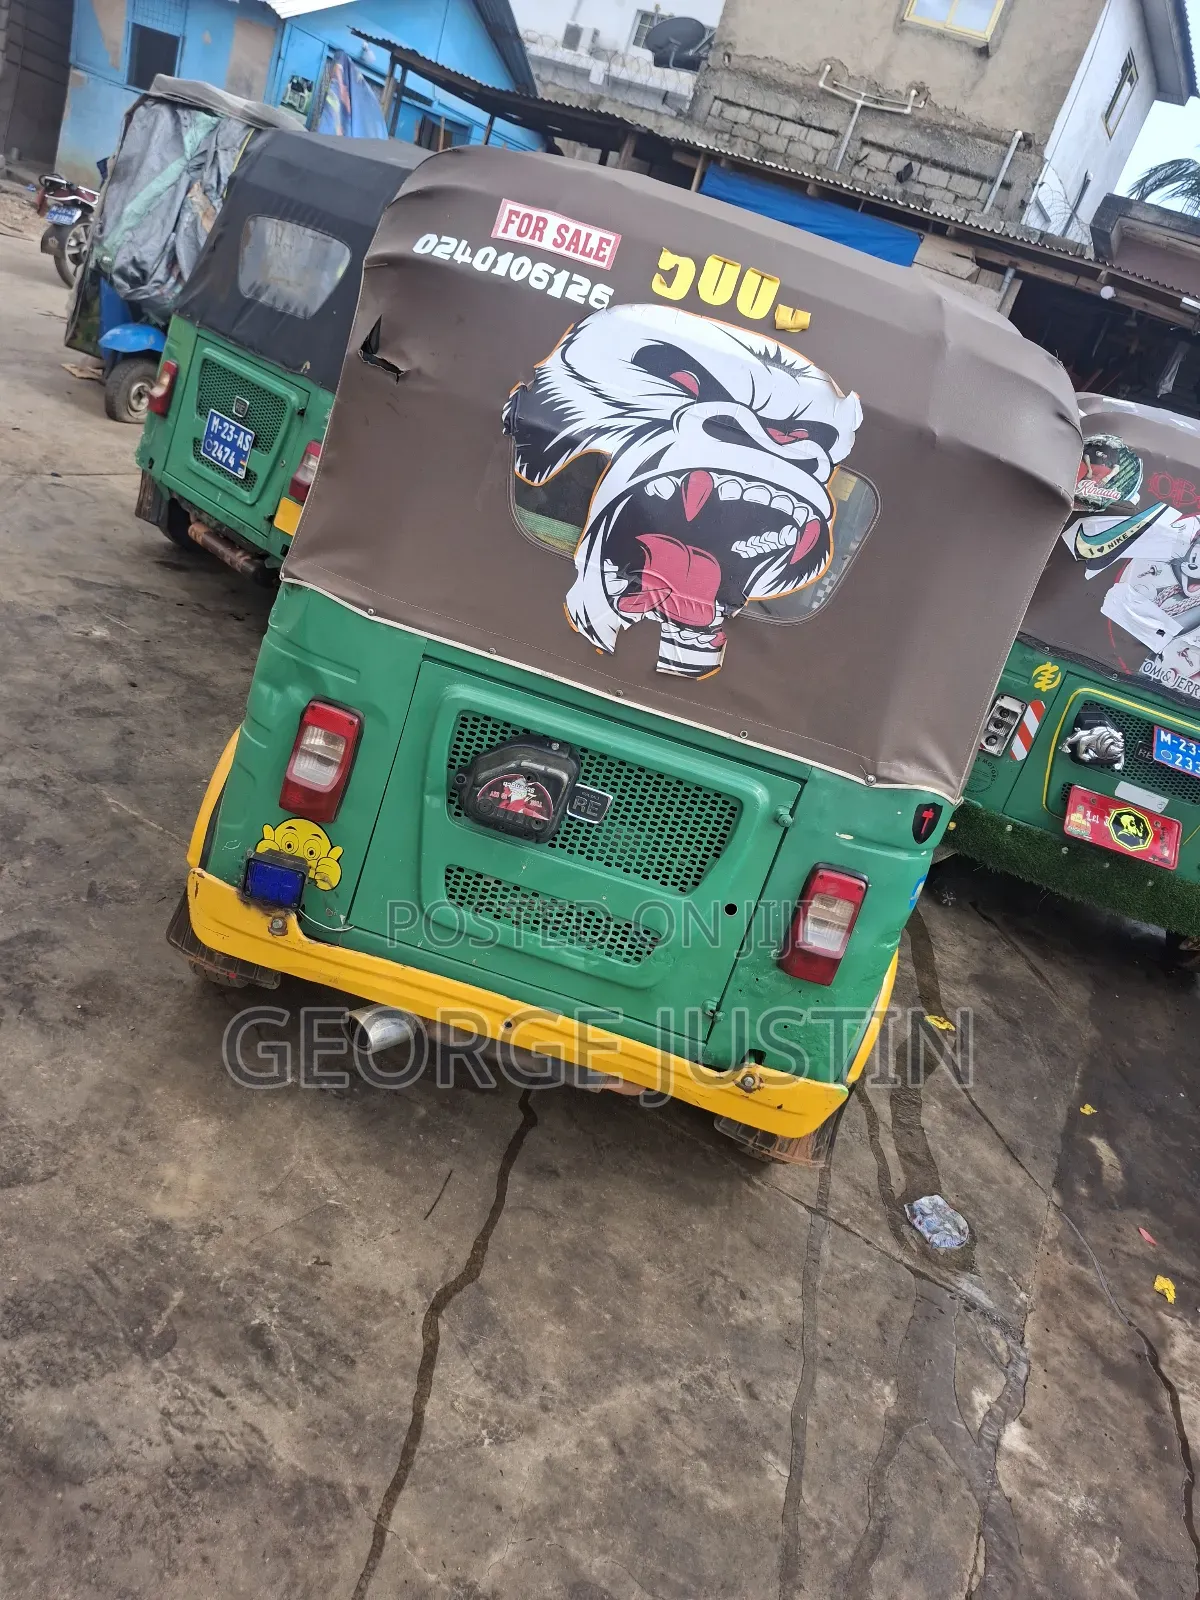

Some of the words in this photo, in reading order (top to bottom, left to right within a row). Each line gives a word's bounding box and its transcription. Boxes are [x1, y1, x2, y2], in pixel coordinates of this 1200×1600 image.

[501, 209, 546, 243] FOR
[552, 223, 613, 262] SALE
[412, 233, 615, 310] 0240106126
[210, 416, 252, 452] M-23-AS
[211, 442, 236, 468] 2474
[1075, 480, 1121, 500] Kinaata
[1107, 533, 1129, 550] NIKE
[573, 795, 601, 816] RE
